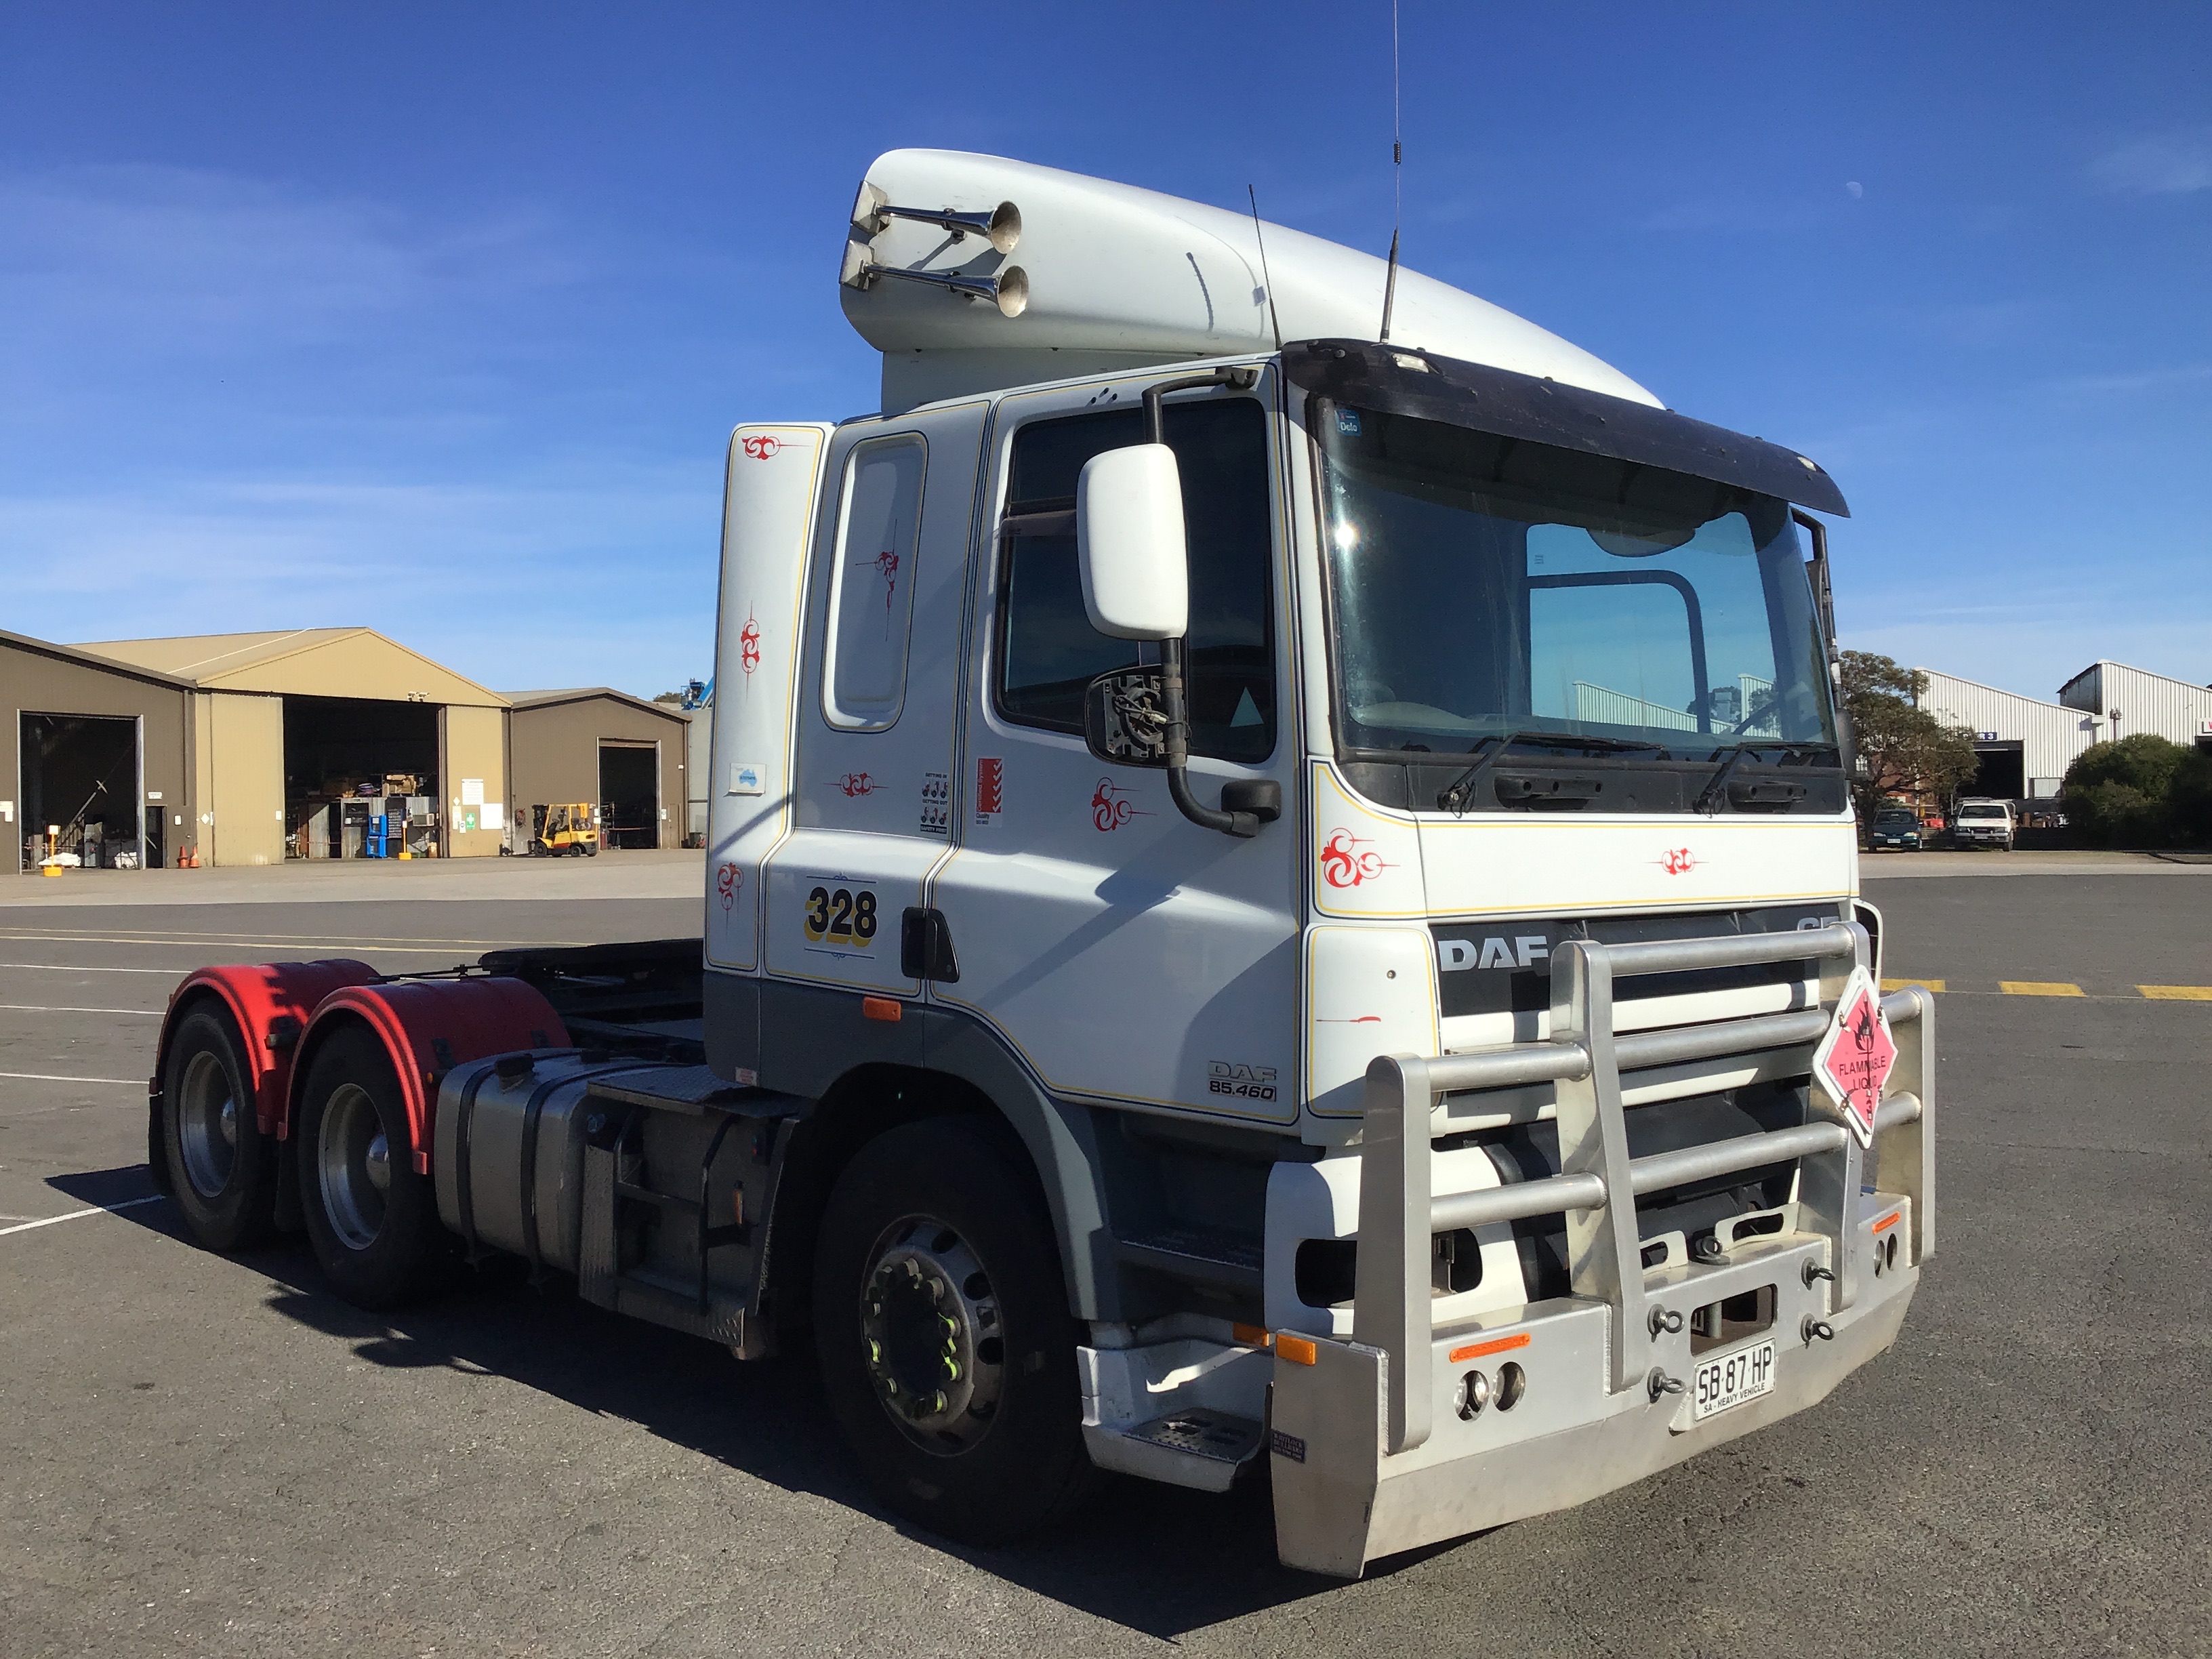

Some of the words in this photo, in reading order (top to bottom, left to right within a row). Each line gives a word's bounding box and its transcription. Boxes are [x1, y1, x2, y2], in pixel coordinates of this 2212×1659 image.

[803, 886, 878, 947] 328
[1437, 935, 1549, 972] DAF
[1208, 1061, 1277, 1082] DAF
[1209, 1080, 1274, 1099] 85.460
[1704, 1404, 1713, 1413] SA
[1717, 1393, 1738, 1408] HEAVY
[1740, 1382, 1765, 1399] VEHICLE
